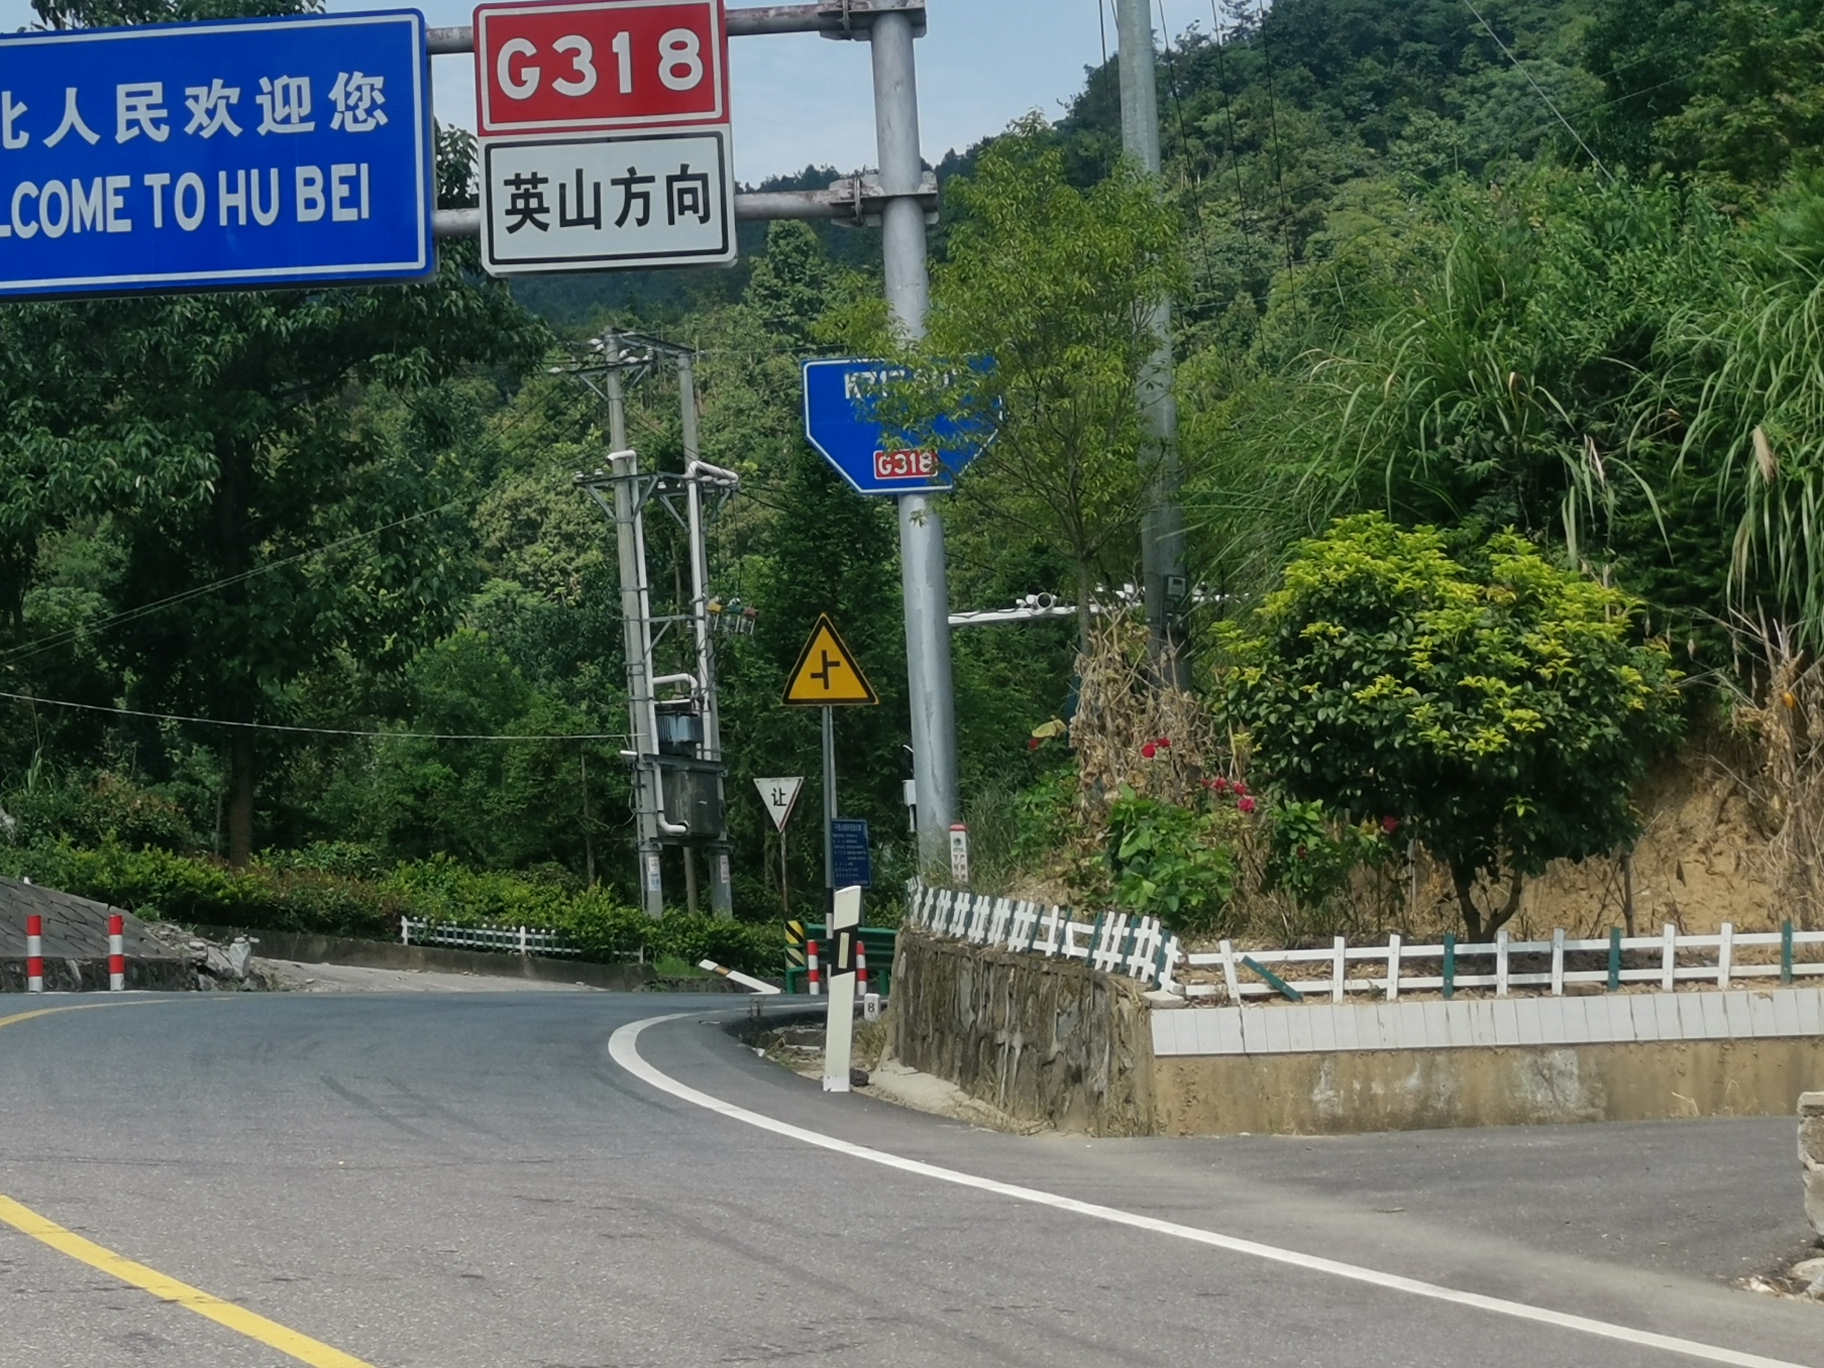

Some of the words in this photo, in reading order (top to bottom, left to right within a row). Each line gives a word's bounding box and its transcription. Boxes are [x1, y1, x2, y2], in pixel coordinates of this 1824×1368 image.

[496, 28, 704, 101] G318
[144, 172, 206, 232] TO
[218, 167, 279, 227] HU
[295, 163, 370, 223] BEI
[503, 163, 712, 235] 英山方向
[878, 452, 933, 475] G318
[771, 787, 787, 807] 让
